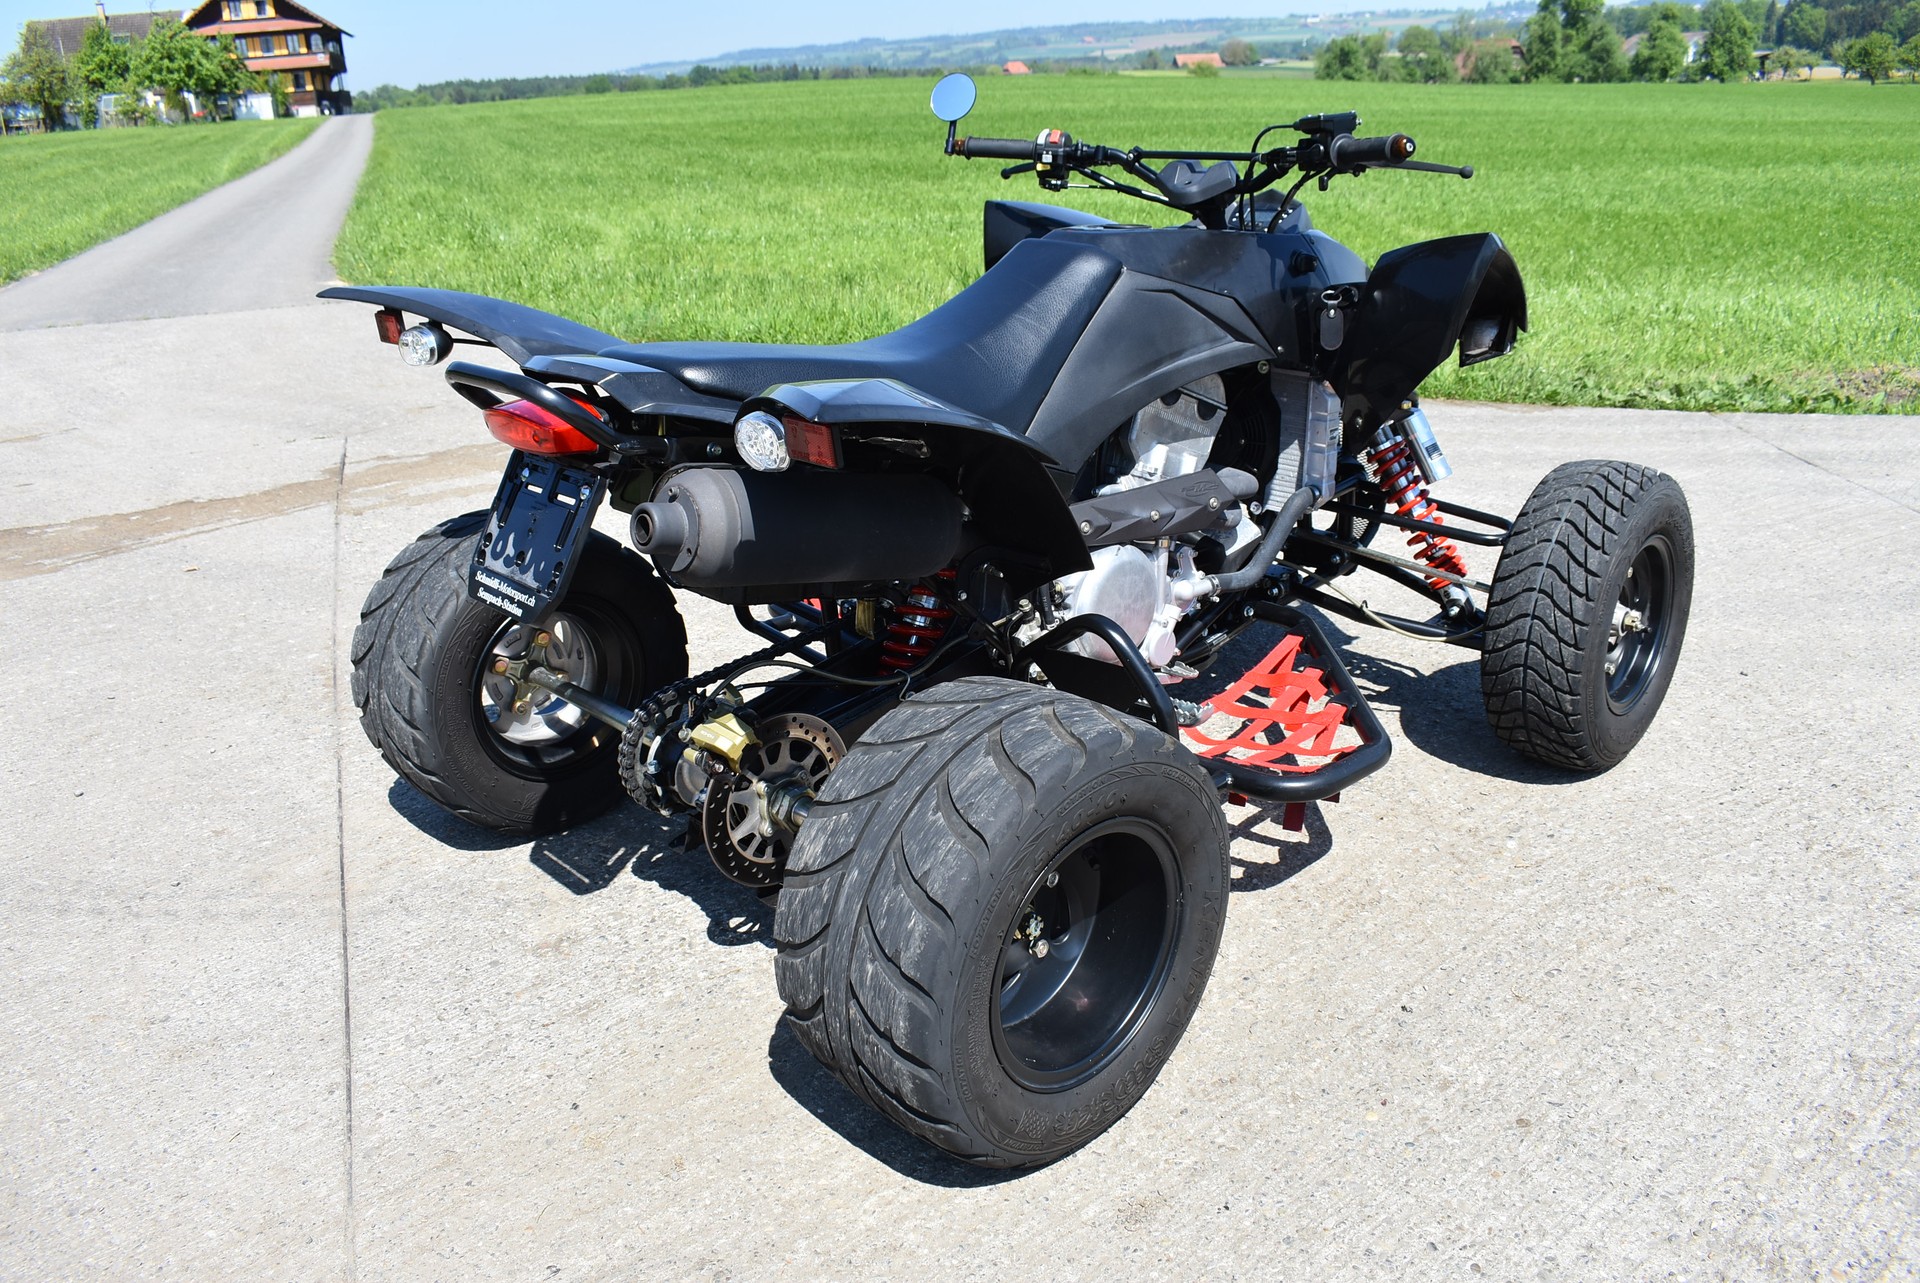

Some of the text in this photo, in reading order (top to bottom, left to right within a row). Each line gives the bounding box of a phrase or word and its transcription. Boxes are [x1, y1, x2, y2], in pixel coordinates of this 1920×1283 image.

[477, 587, 523, 617] Sempach-Station
[968, 886, 1003, 960] ROTATION
[955, 1047, 973, 1103] ROTATION
